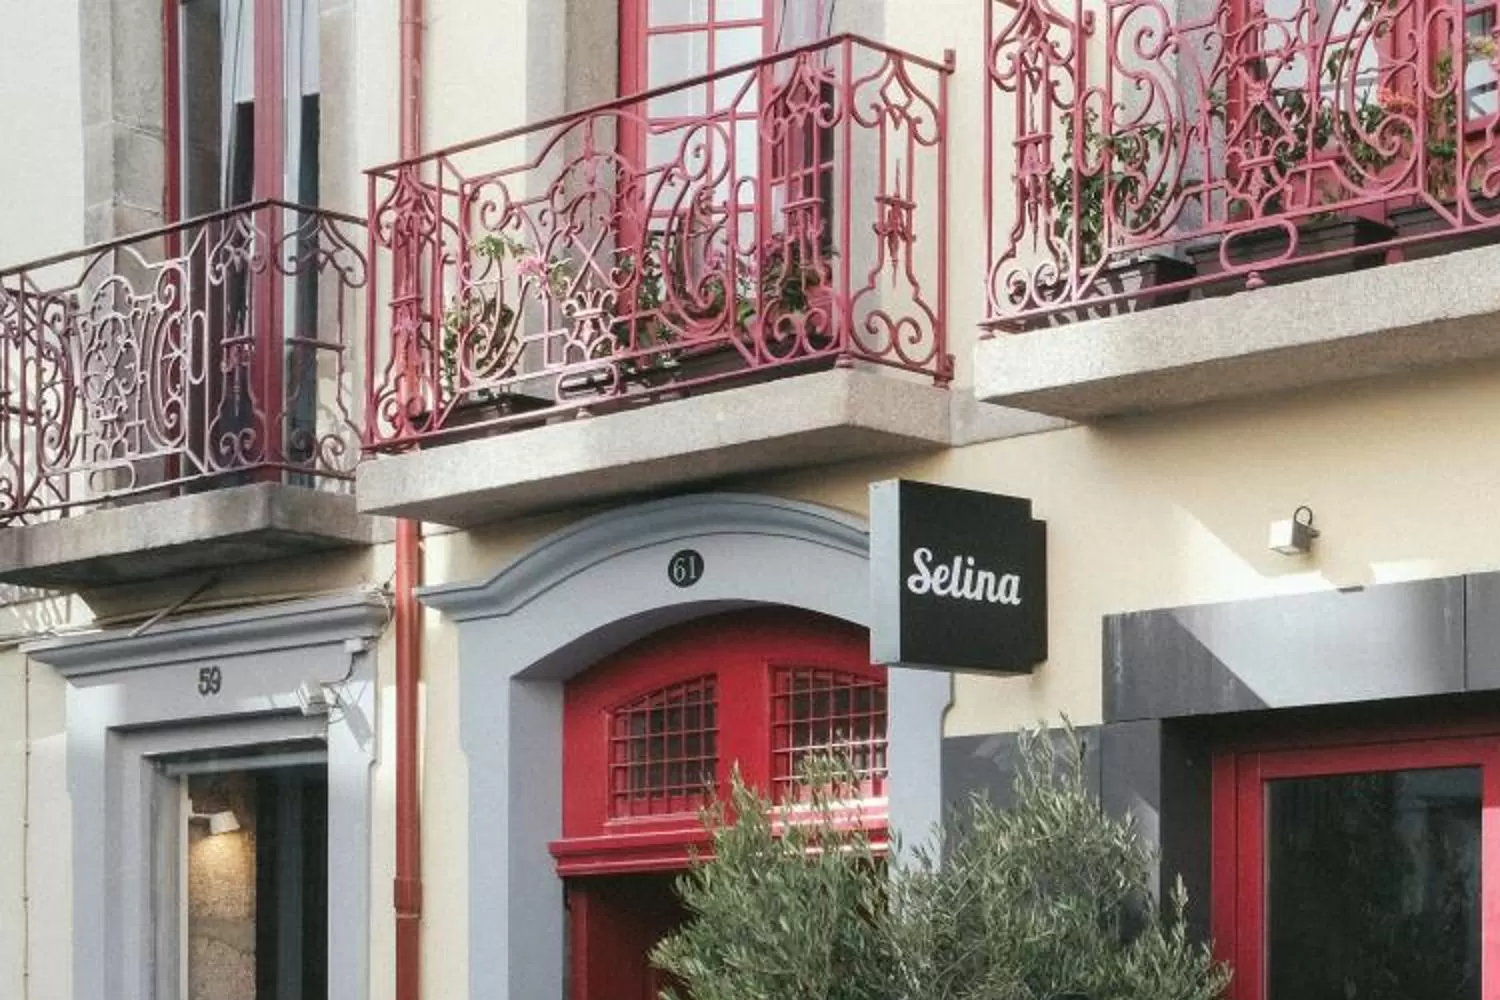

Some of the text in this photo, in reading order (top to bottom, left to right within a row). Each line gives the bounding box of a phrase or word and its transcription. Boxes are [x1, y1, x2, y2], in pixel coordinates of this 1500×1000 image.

[673, 555, 697, 581] 61
[907, 547, 1021, 605] Selina
[198, 666, 222, 695] 59
